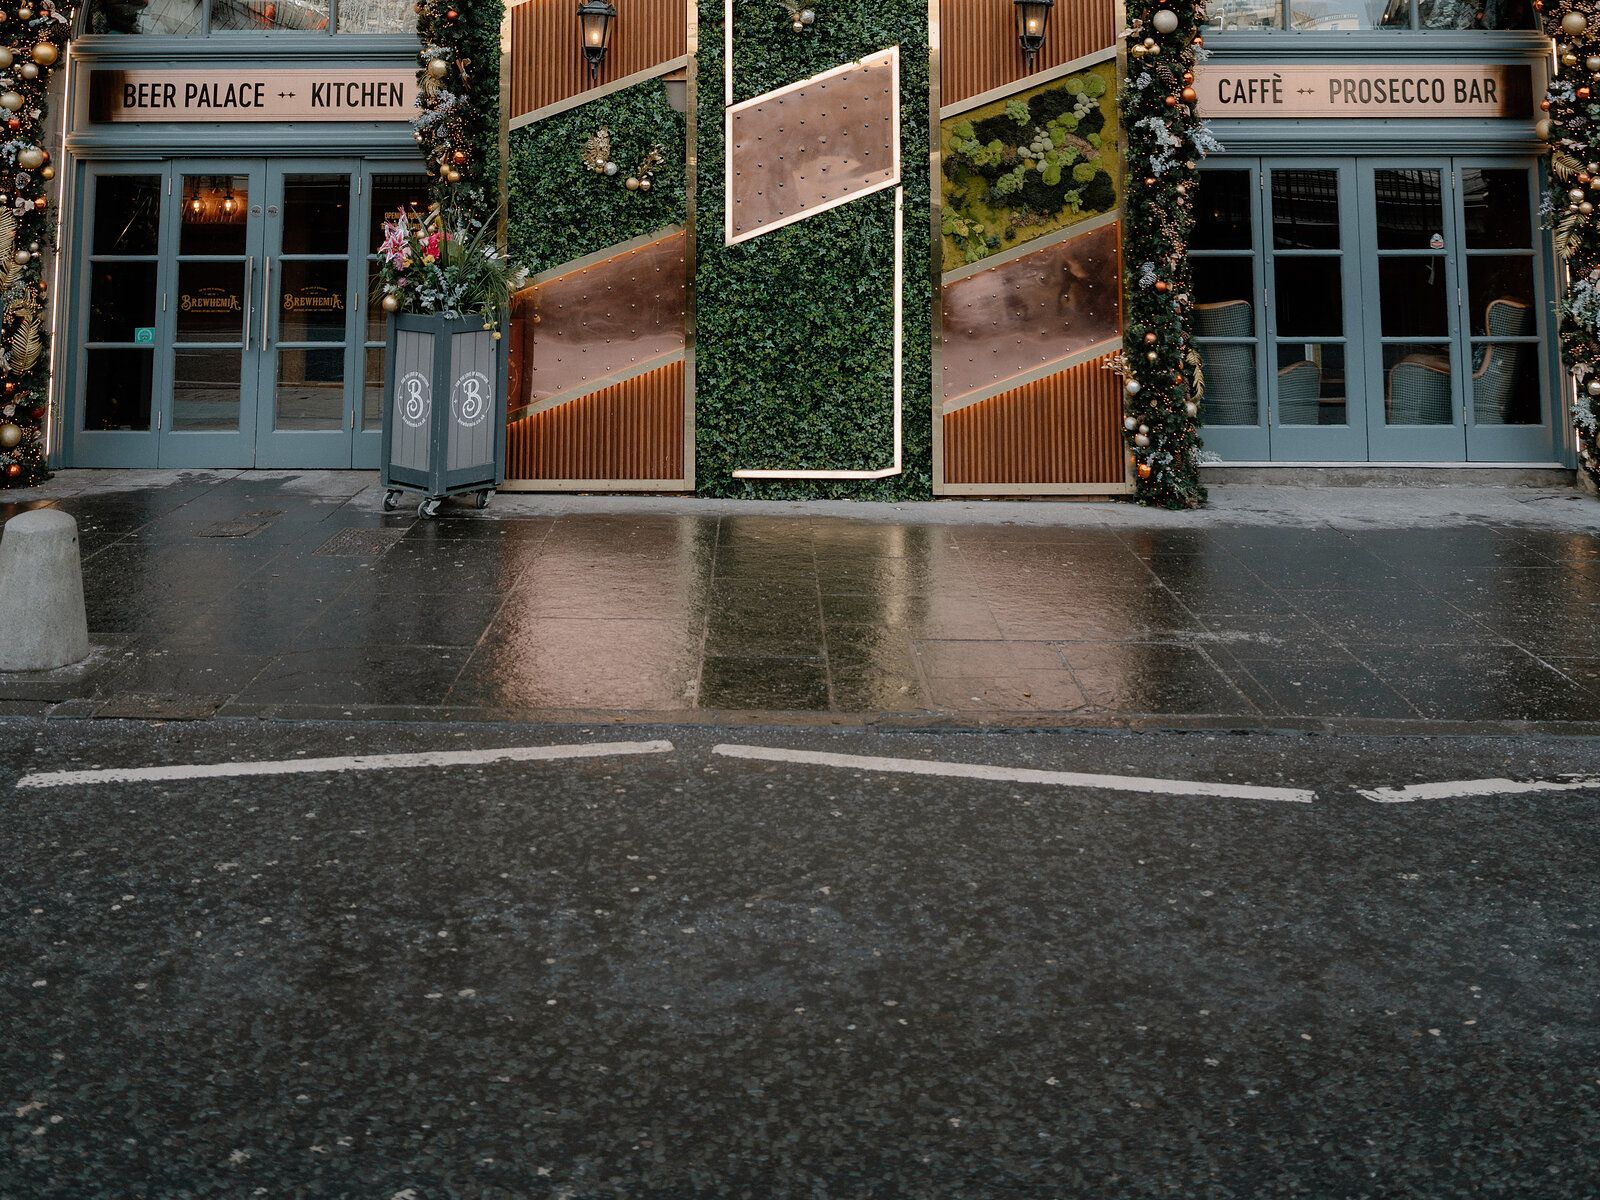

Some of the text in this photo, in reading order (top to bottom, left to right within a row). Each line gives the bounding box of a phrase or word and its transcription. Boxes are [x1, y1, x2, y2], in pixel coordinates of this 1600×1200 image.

[123, 82, 404, 108] BEER PALACE KITCHEN
[1218, 73, 1498, 104] CAFFÈ PROSECCO BAR
[181, 294, 242, 311] BREWHEMIA
[283, 293, 345, 310] BREWHEMIA
